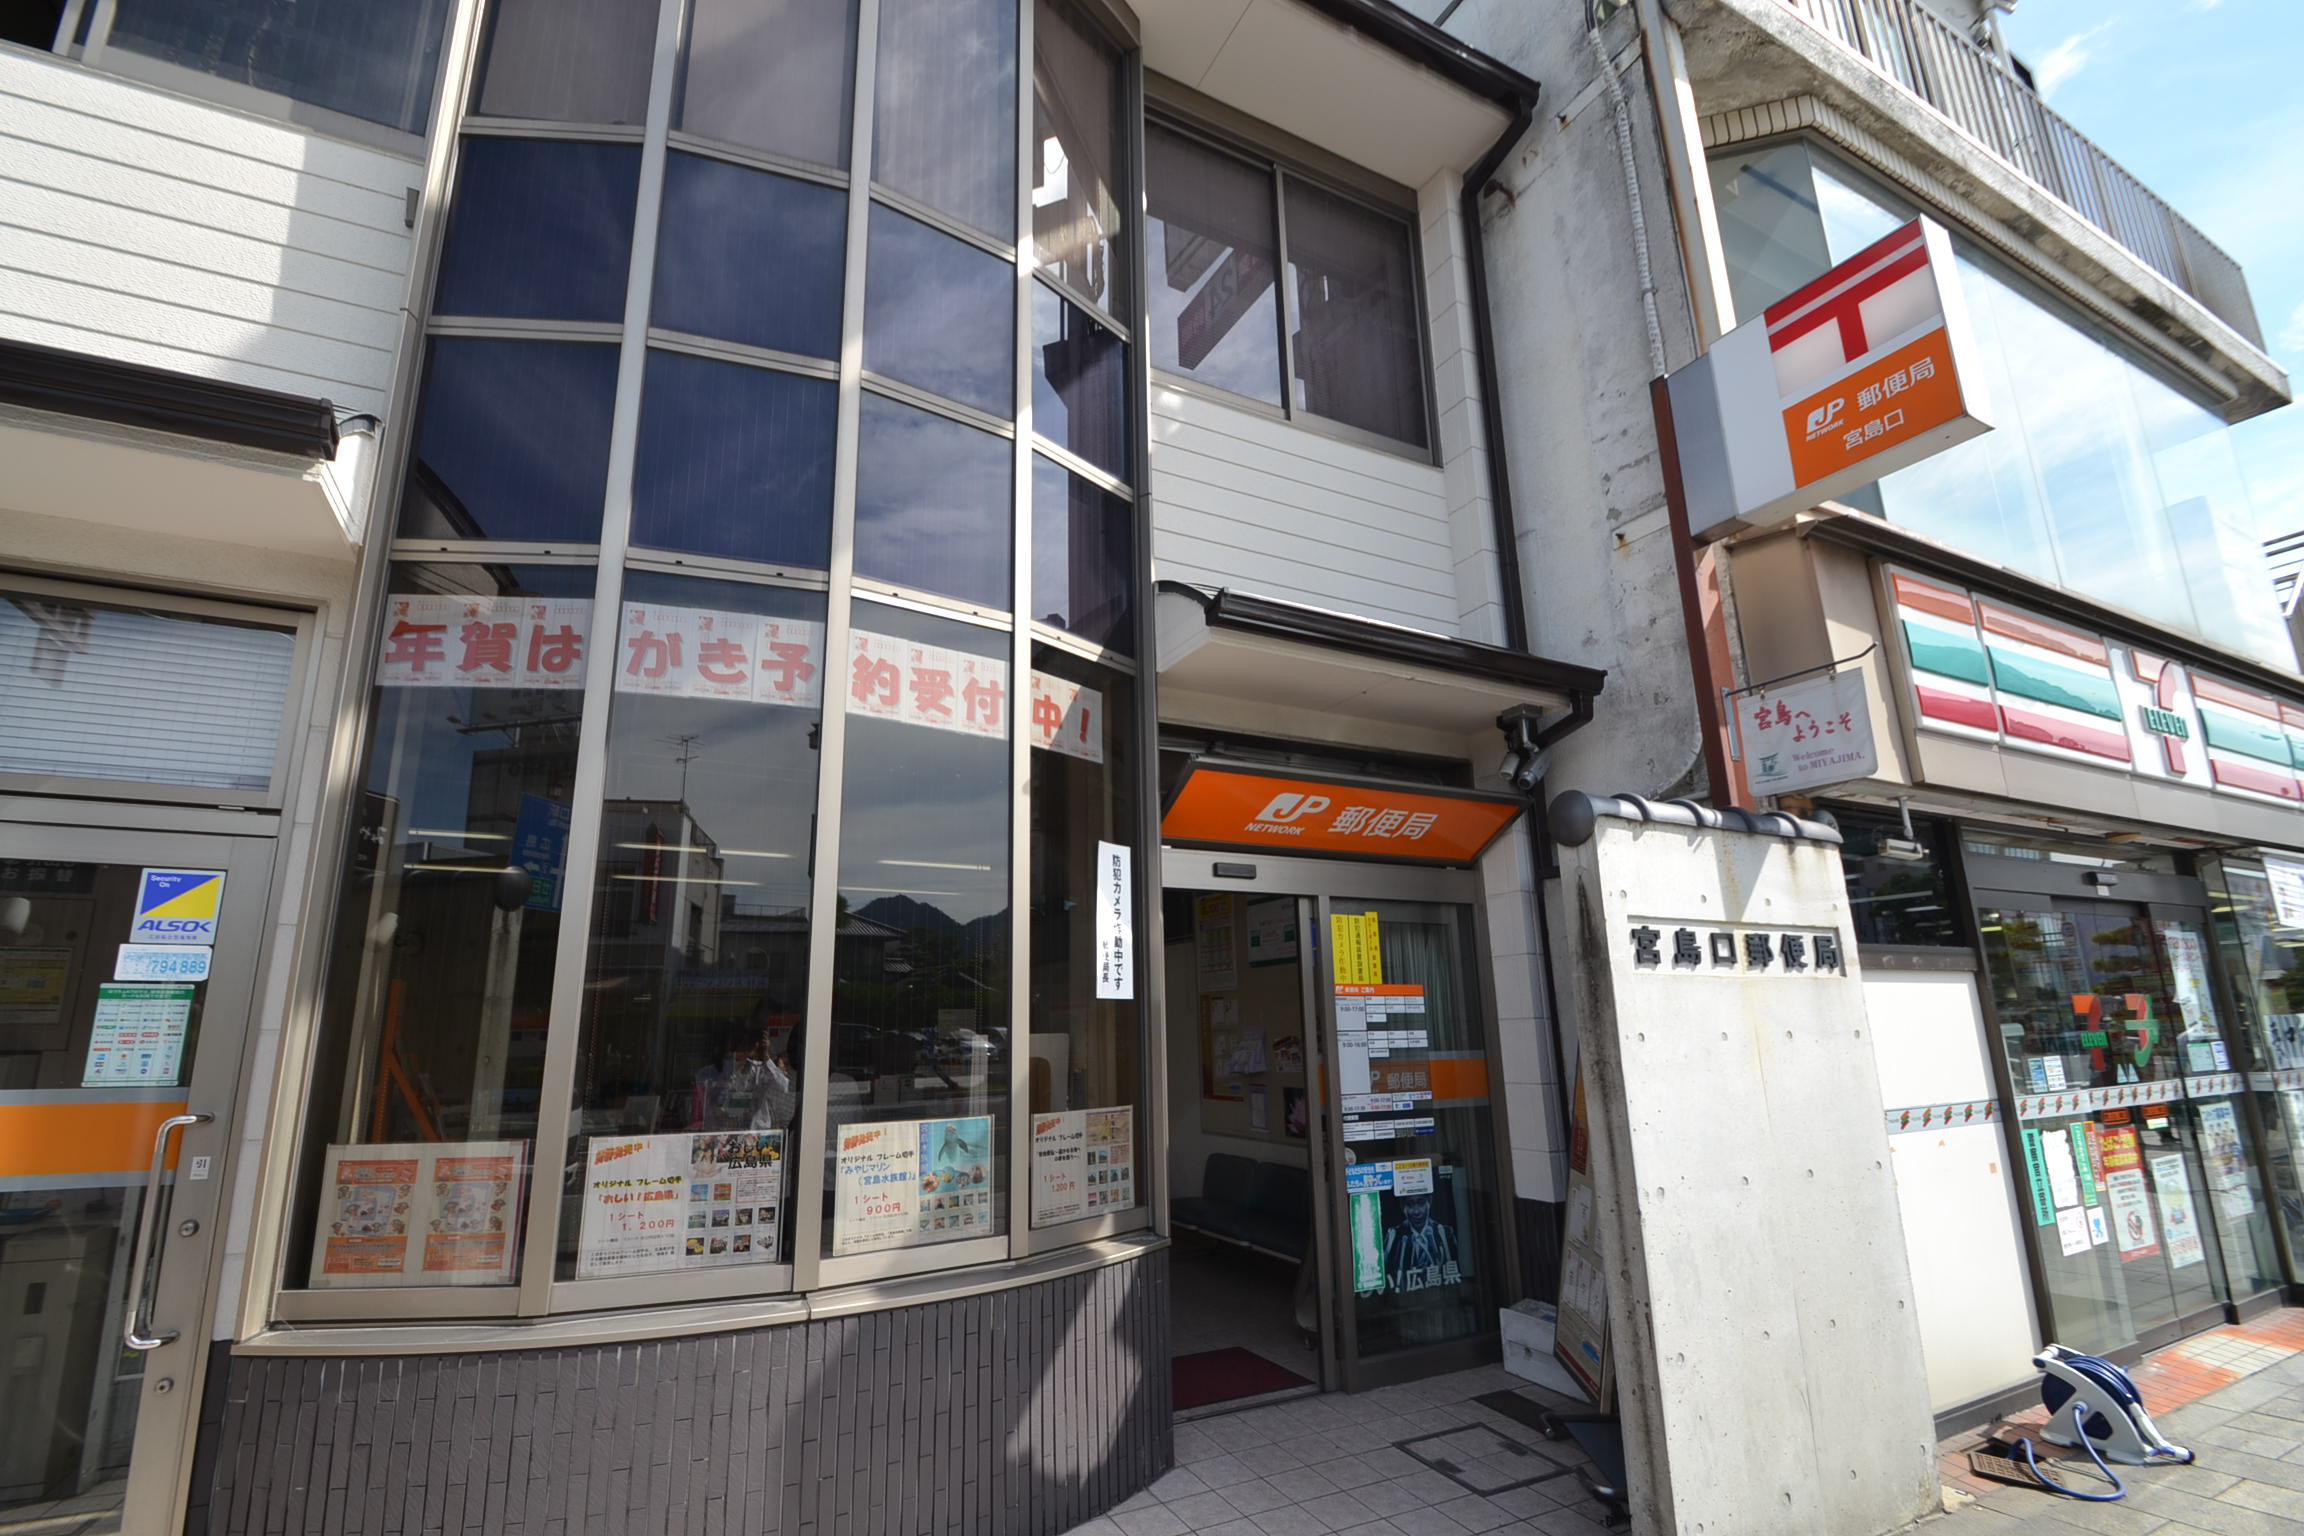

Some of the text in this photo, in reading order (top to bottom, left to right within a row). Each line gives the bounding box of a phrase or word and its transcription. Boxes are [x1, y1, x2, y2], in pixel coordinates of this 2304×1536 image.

[1857, 357, 1936, 411] 郵便局
[1805, 417, 1845, 442] NETWORK
[1843, 408, 1904, 450] 宮島口
[1792, 711, 1853, 742] ようこそ
[1792, 748, 1835, 761] Welcome
[1245, 822, 1305, 836] NETWORK
[1328, 805, 1439, 840] 郵便局
[151, 874, 182, 883] Security
[138, 919, 211, 933] ALSOK
[1630, 925, 1839, 970] 宮島口郵便局
[1387, 1071, 1427, 1089] 郵便局
[866, 1202, 901, 1215] 900円
